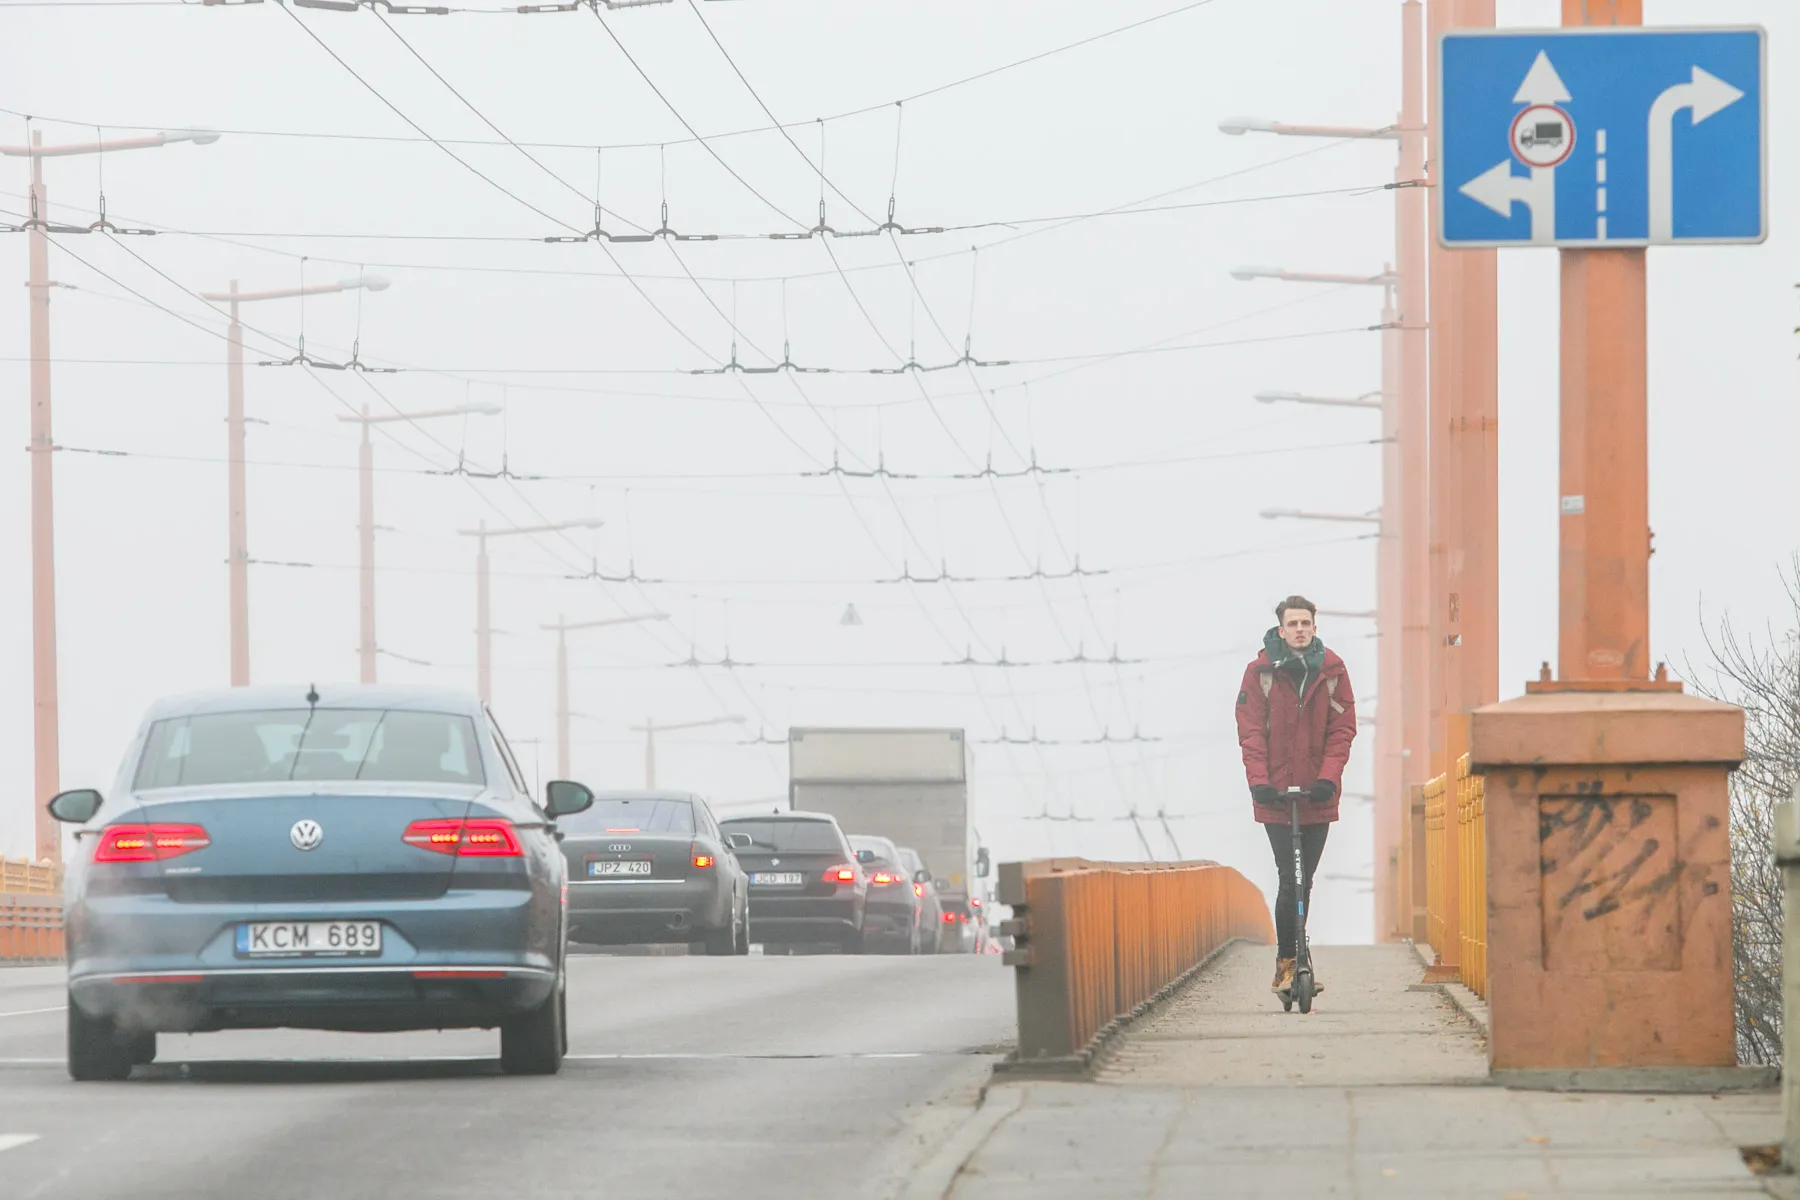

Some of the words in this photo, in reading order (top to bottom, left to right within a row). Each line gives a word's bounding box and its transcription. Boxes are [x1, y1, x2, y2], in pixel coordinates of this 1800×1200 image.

[595, 862, 620, 873] JPZ
[628, 862, 649, 873] 420
[253, 924, 309, 948] KCM
[328, 924, 375, 947] 689
